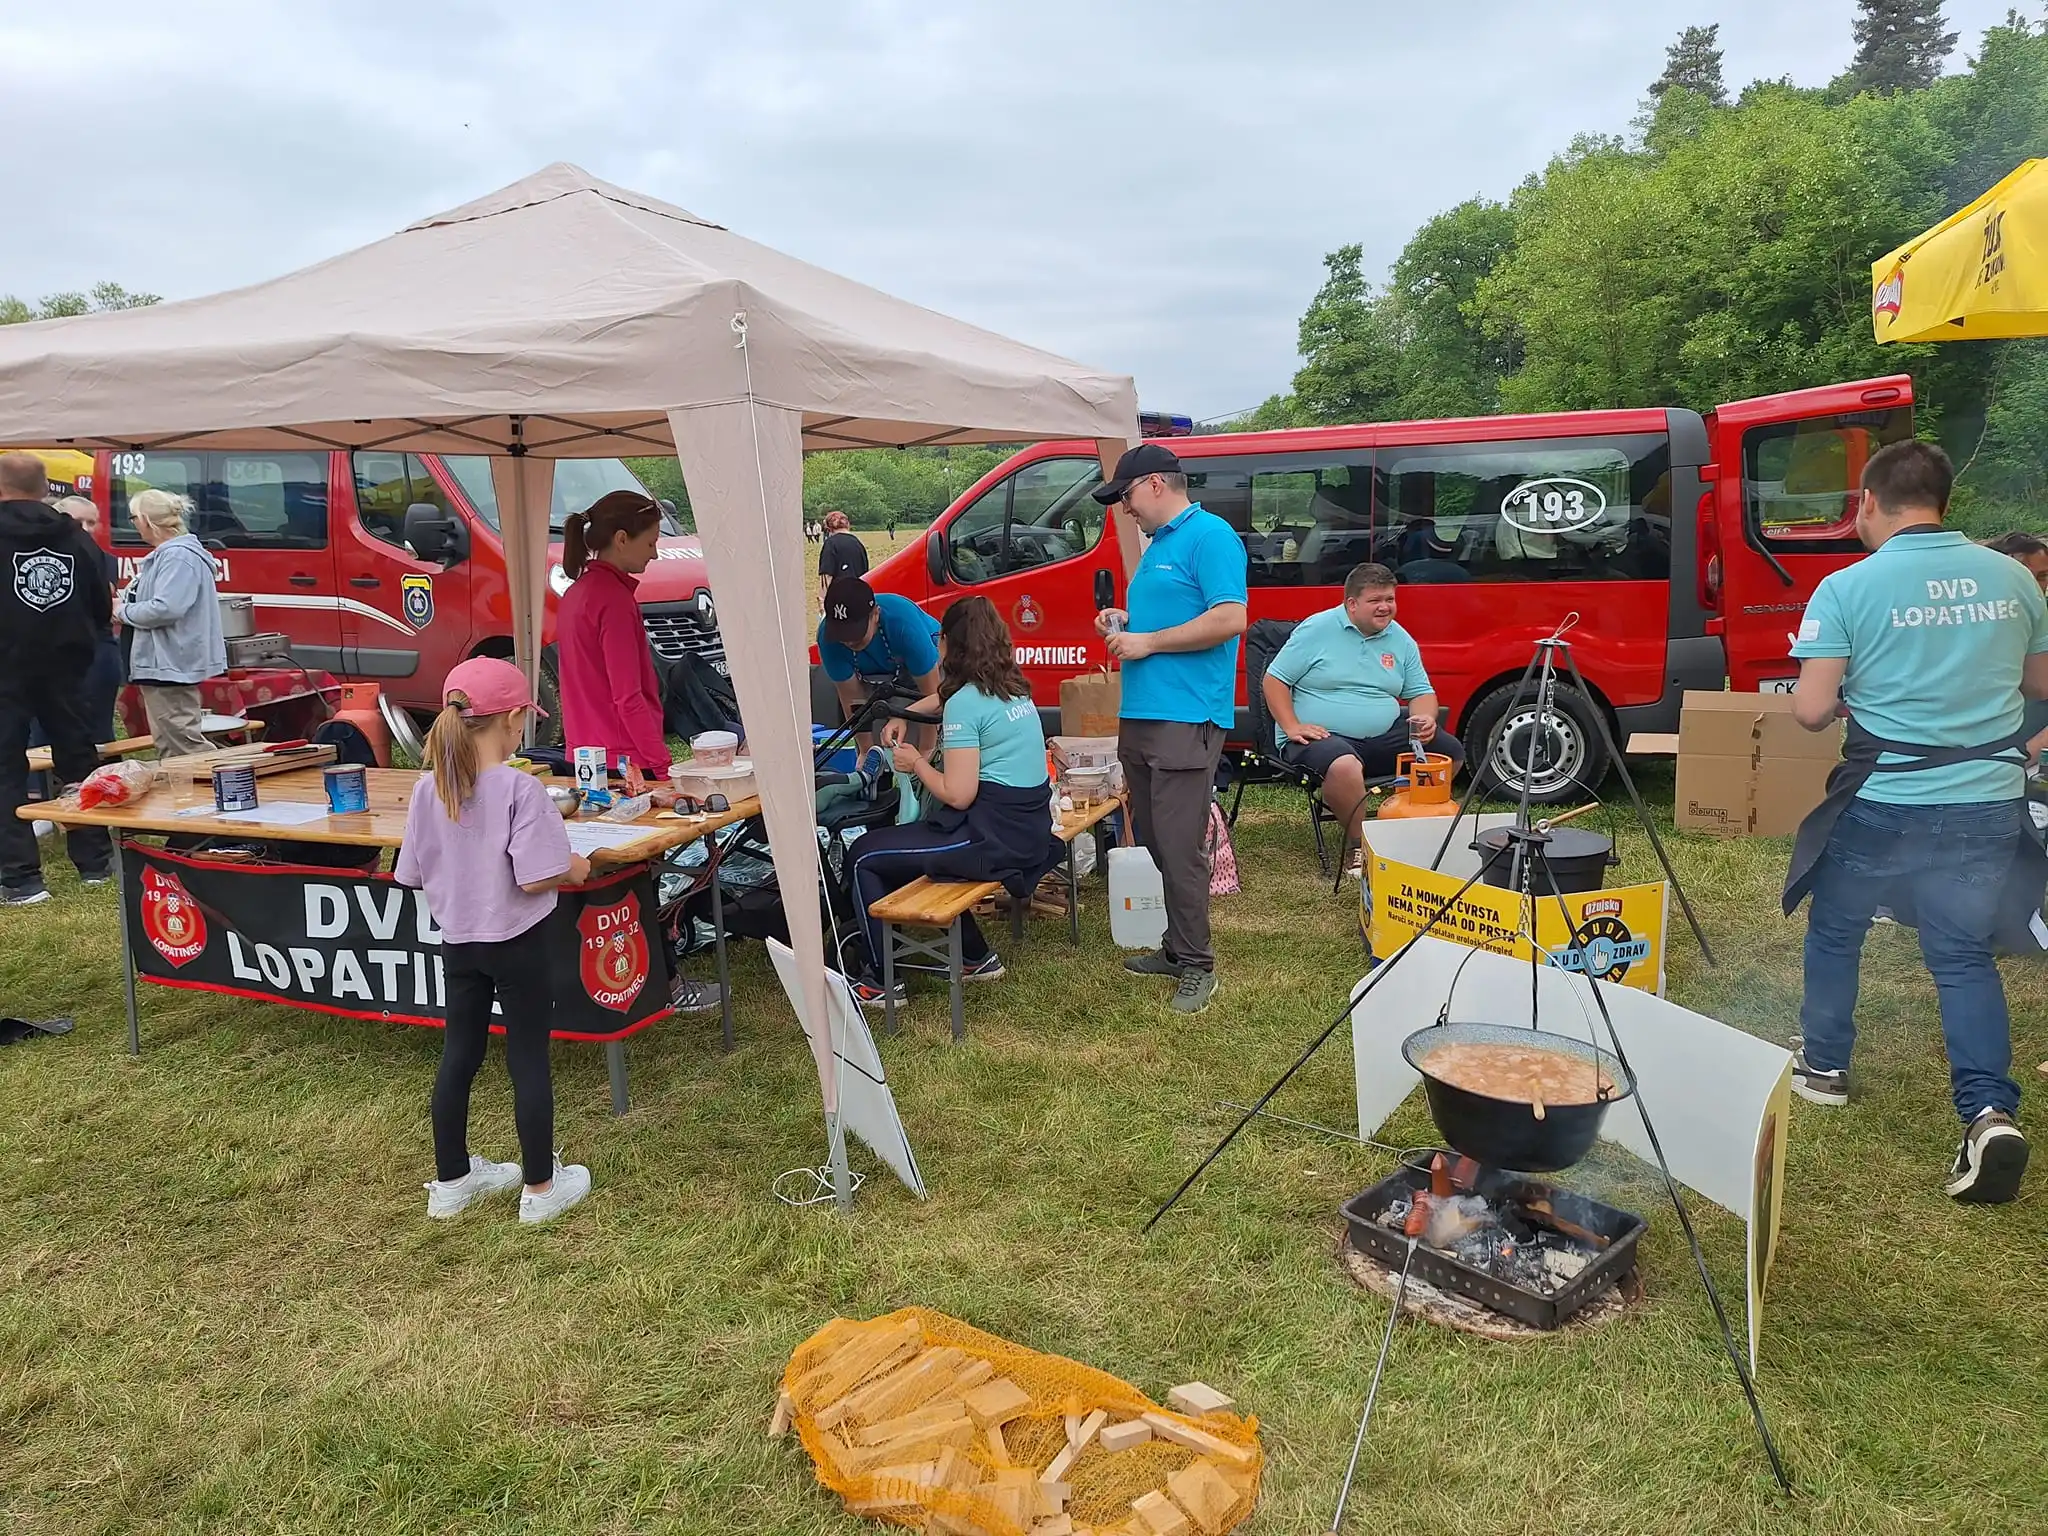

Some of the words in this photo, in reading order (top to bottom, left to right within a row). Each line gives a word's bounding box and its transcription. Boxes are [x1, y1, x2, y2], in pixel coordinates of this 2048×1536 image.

[112, 453, 145, 475] 193
[1523, 490, 1585, 522] 193
[1926, 578, 1978, 600] DVD
[1891, 600, 2020, 628] LOPATINEC
[1014, 646, 1087, 665] OPATINEC
[146, 890, 161, 902] 19
[1401, 884, 1413, 898] ZA
[1457, 897, 1500, 923] ČVRSTA
[597, 905, 631, 930] DVD
[1387, 894, 1414, 914] NEMA
[1461, 917, 1475, 932] OD
[1387, 911, 1406, 925] Naruči
[1407, 919, 1415, 927] se
[1424, 924, 1455, 940] esplatan
[586, 935, 605, 950] 19
[628, 921, 639, 936] 32
[1578, 921, 1624, 945] BUDI
[153, 937, 202, 958] LOPATINEC
[1551, 953, 1581, 967] BUD
[1613, 943, 1645, 960] ZDRAV
[226, 930, 505, 1016] LOPATI
[593, 973, 645, 1005] LOPATINEC
